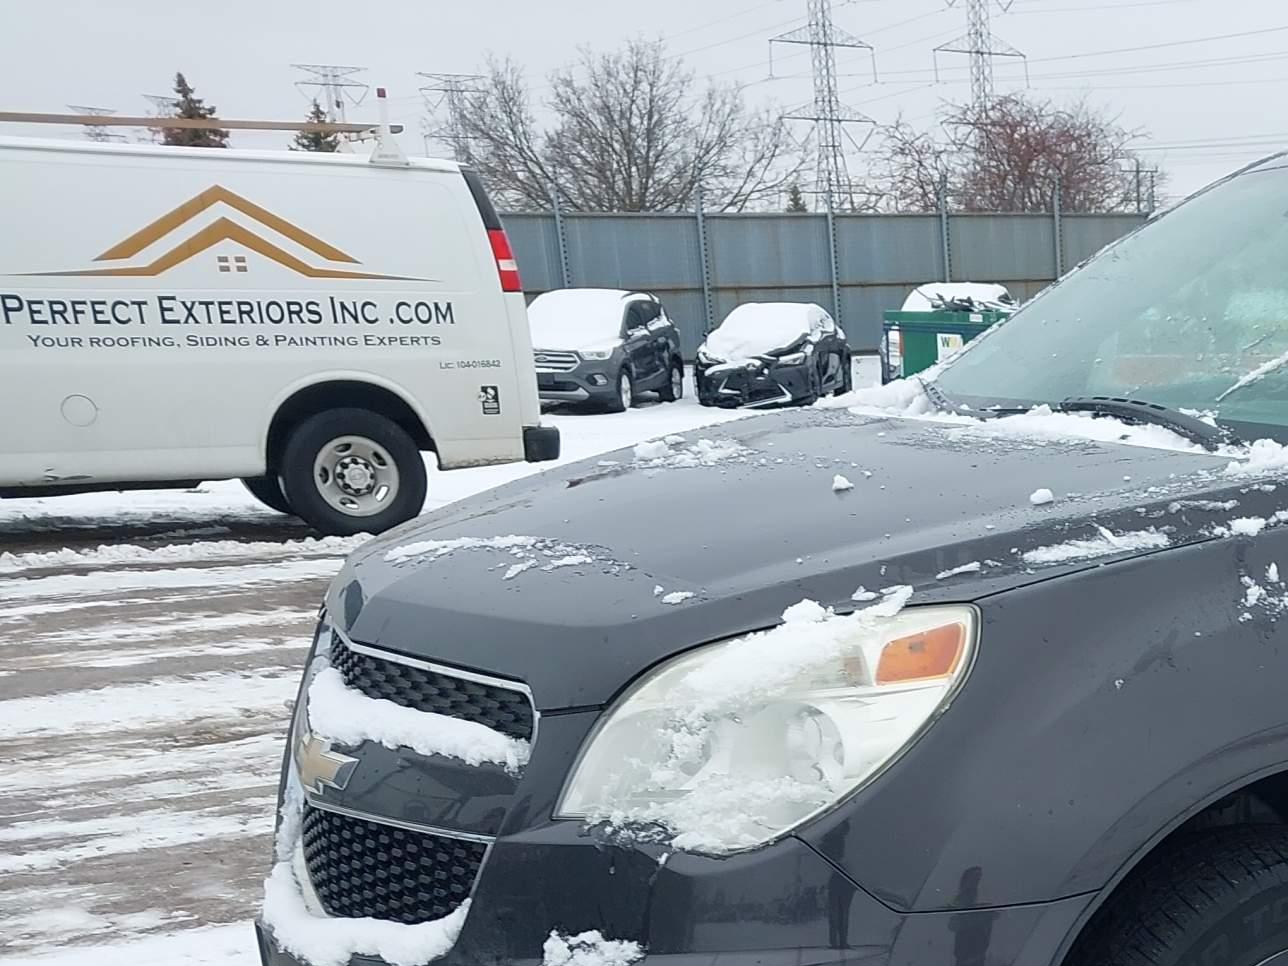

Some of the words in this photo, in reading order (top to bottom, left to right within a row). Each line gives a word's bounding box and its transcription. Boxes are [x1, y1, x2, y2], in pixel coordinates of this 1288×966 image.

[0, 294, 148, 325] PERFECT
[157, 295, 323, 325] EXTERIORS
[329, 296, 379, 325] INC
[388, 301, 455, 325] .COM
[27, 335, 83, 348] YOUR
[88, 337, 181, 349] ROOFING,
[186, 334, 250, 347] SIDING
[255, 335, 270, 346] &
[274, 334, 359, 347] PAINTING
[363, 334, 442, 347] EXPERTS
